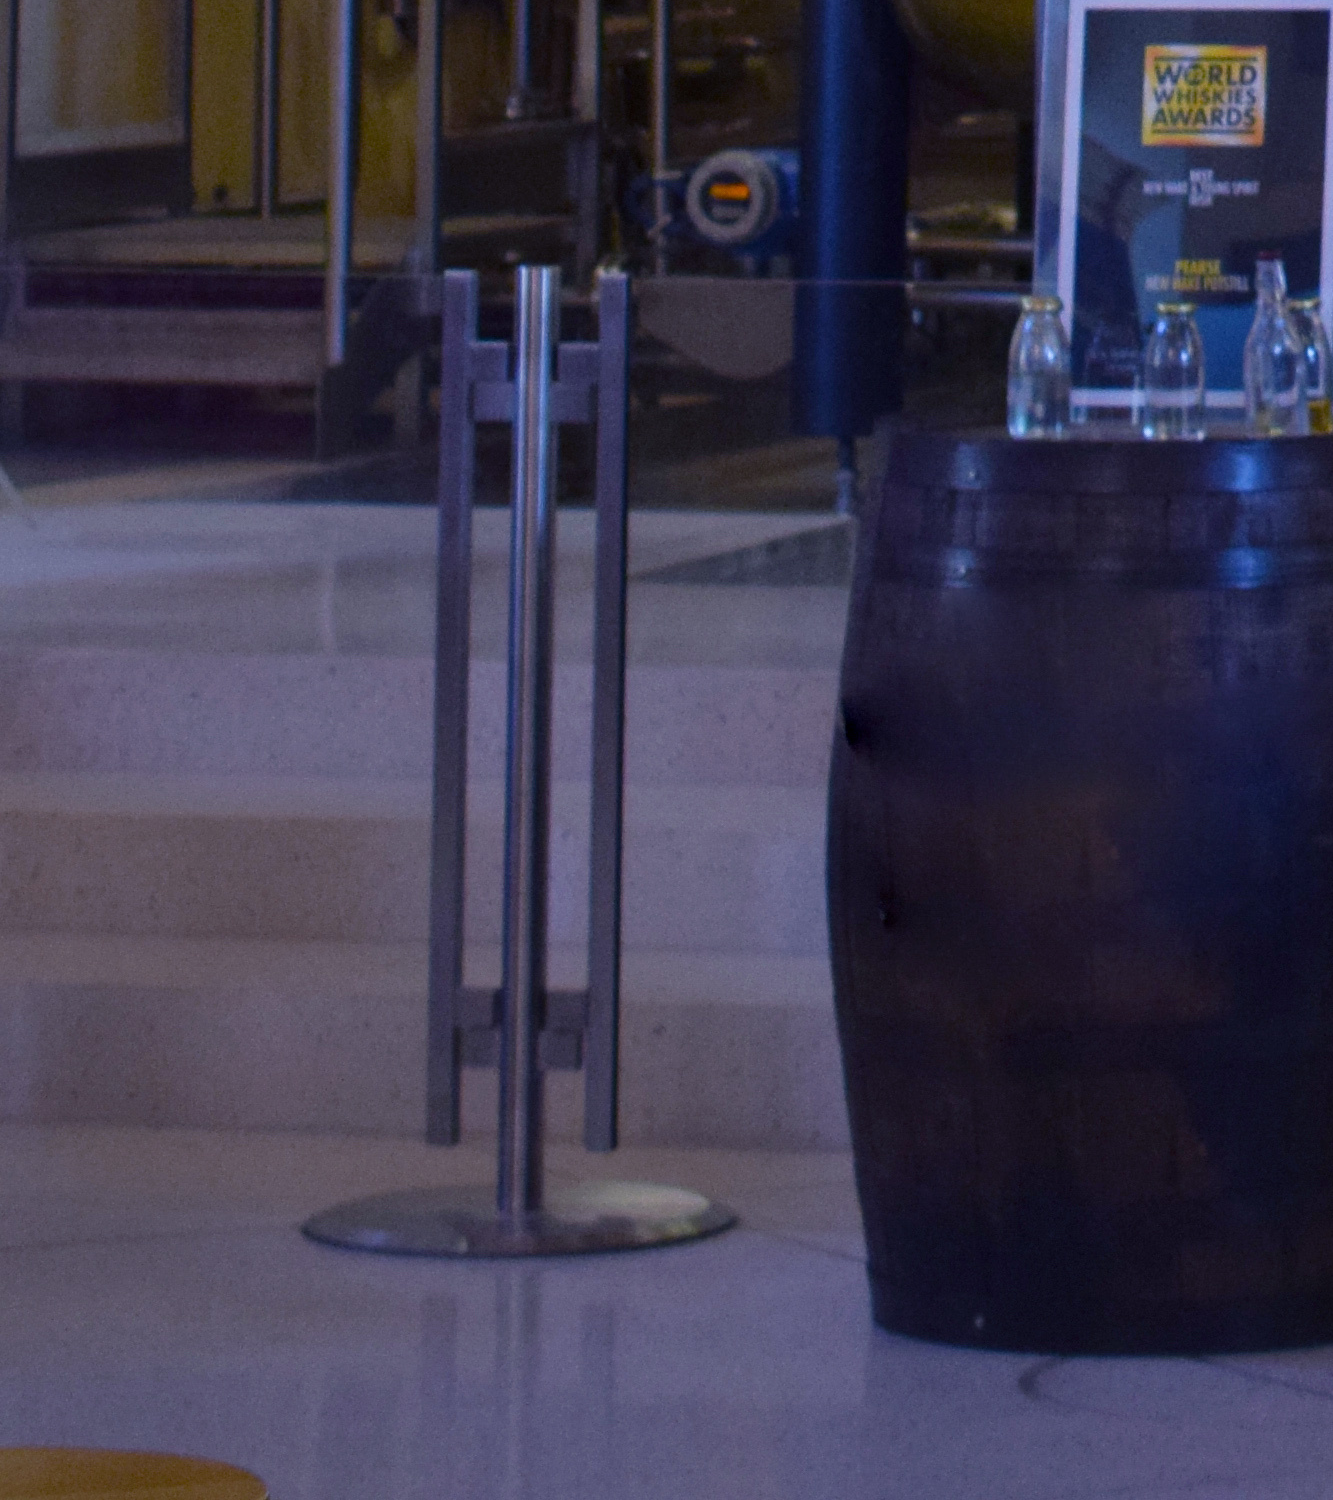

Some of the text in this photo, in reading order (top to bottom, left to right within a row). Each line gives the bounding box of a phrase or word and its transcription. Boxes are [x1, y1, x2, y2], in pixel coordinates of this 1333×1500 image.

[1154, 62, 1257, 86] WORLD
[1153, 87, 1257, 105] WHISKIES
[1151, 107, 1255, 127] AWARDS
